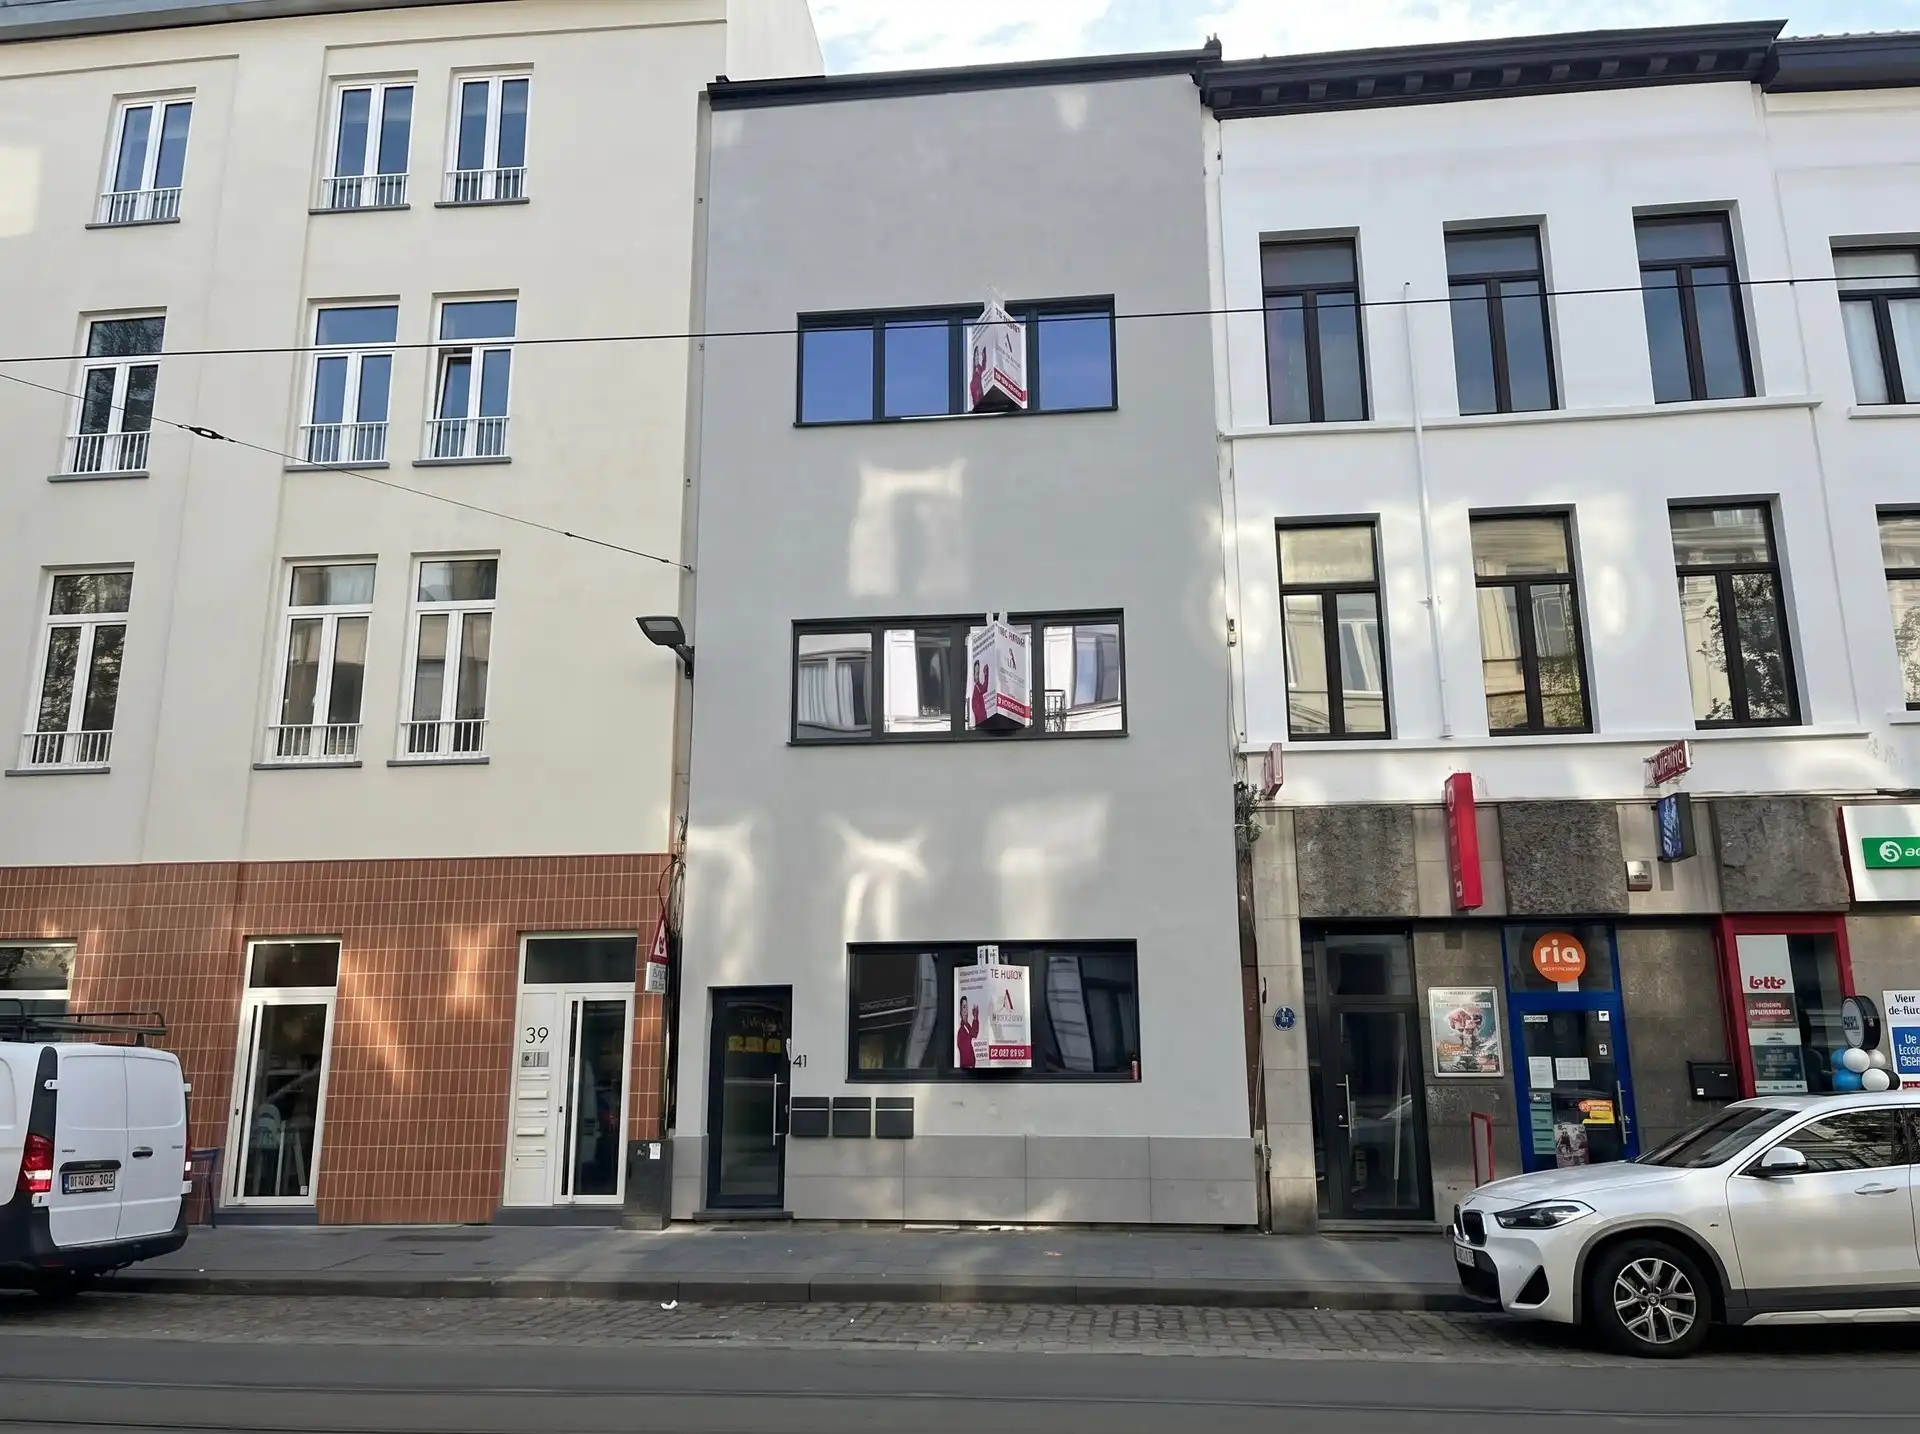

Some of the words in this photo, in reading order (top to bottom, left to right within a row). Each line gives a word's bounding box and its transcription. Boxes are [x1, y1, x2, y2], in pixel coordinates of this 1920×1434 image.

[1540, 939, 1580, 964] ria
[525, 1026, 549, 1044] 39
[792, 1054, 807, 1068] 41
